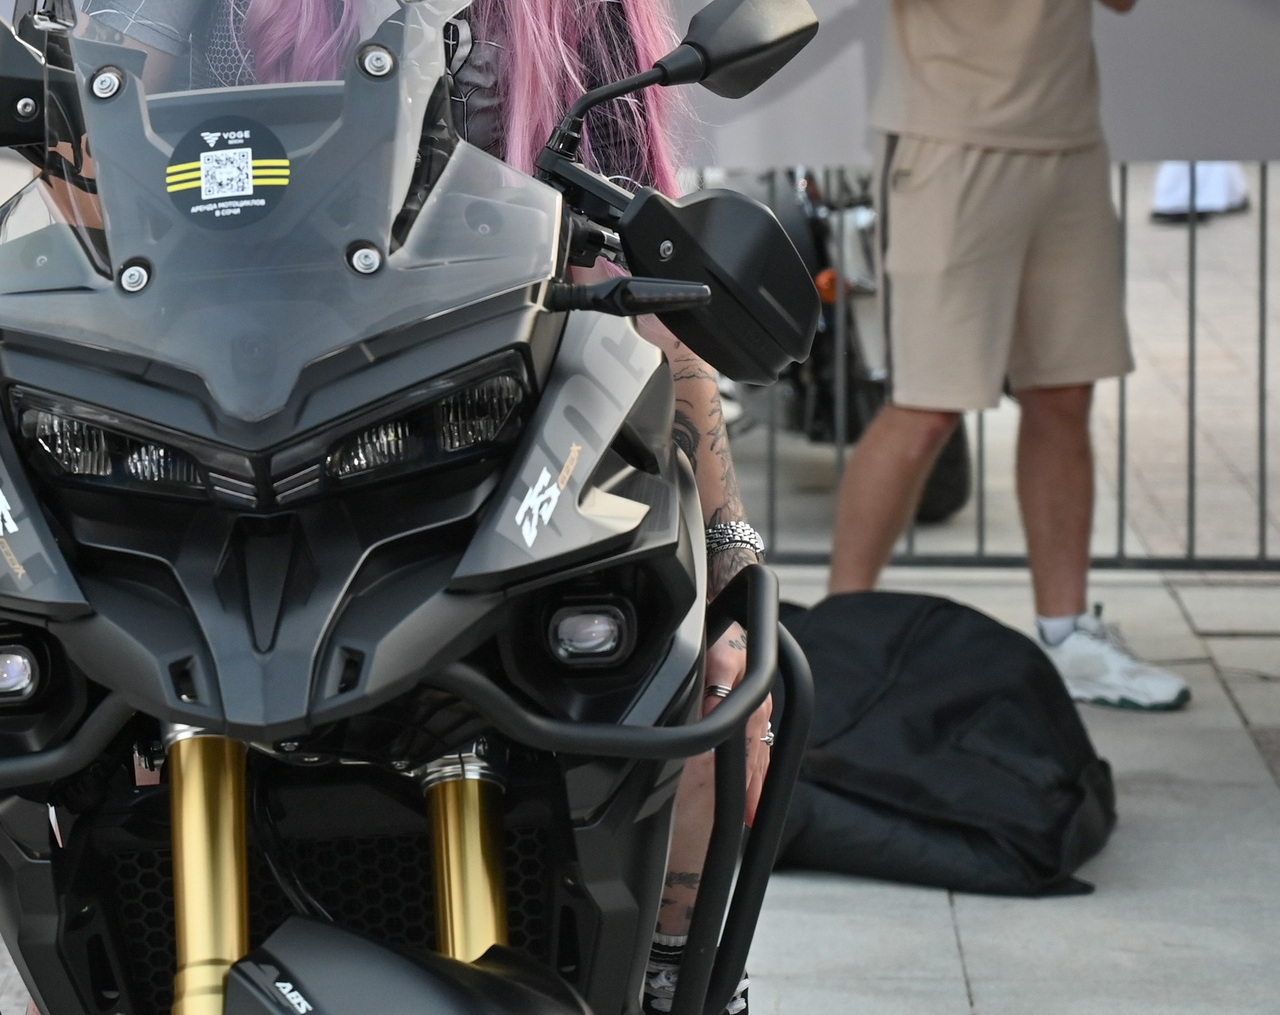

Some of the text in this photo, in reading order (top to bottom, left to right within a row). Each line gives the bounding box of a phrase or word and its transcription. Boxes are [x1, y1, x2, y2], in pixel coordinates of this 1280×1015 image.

[222, 130, 251, 140] VOGE
[190, 203, 218, 214] АРЕНДА
[275, 981, 313, 1014] ABS
